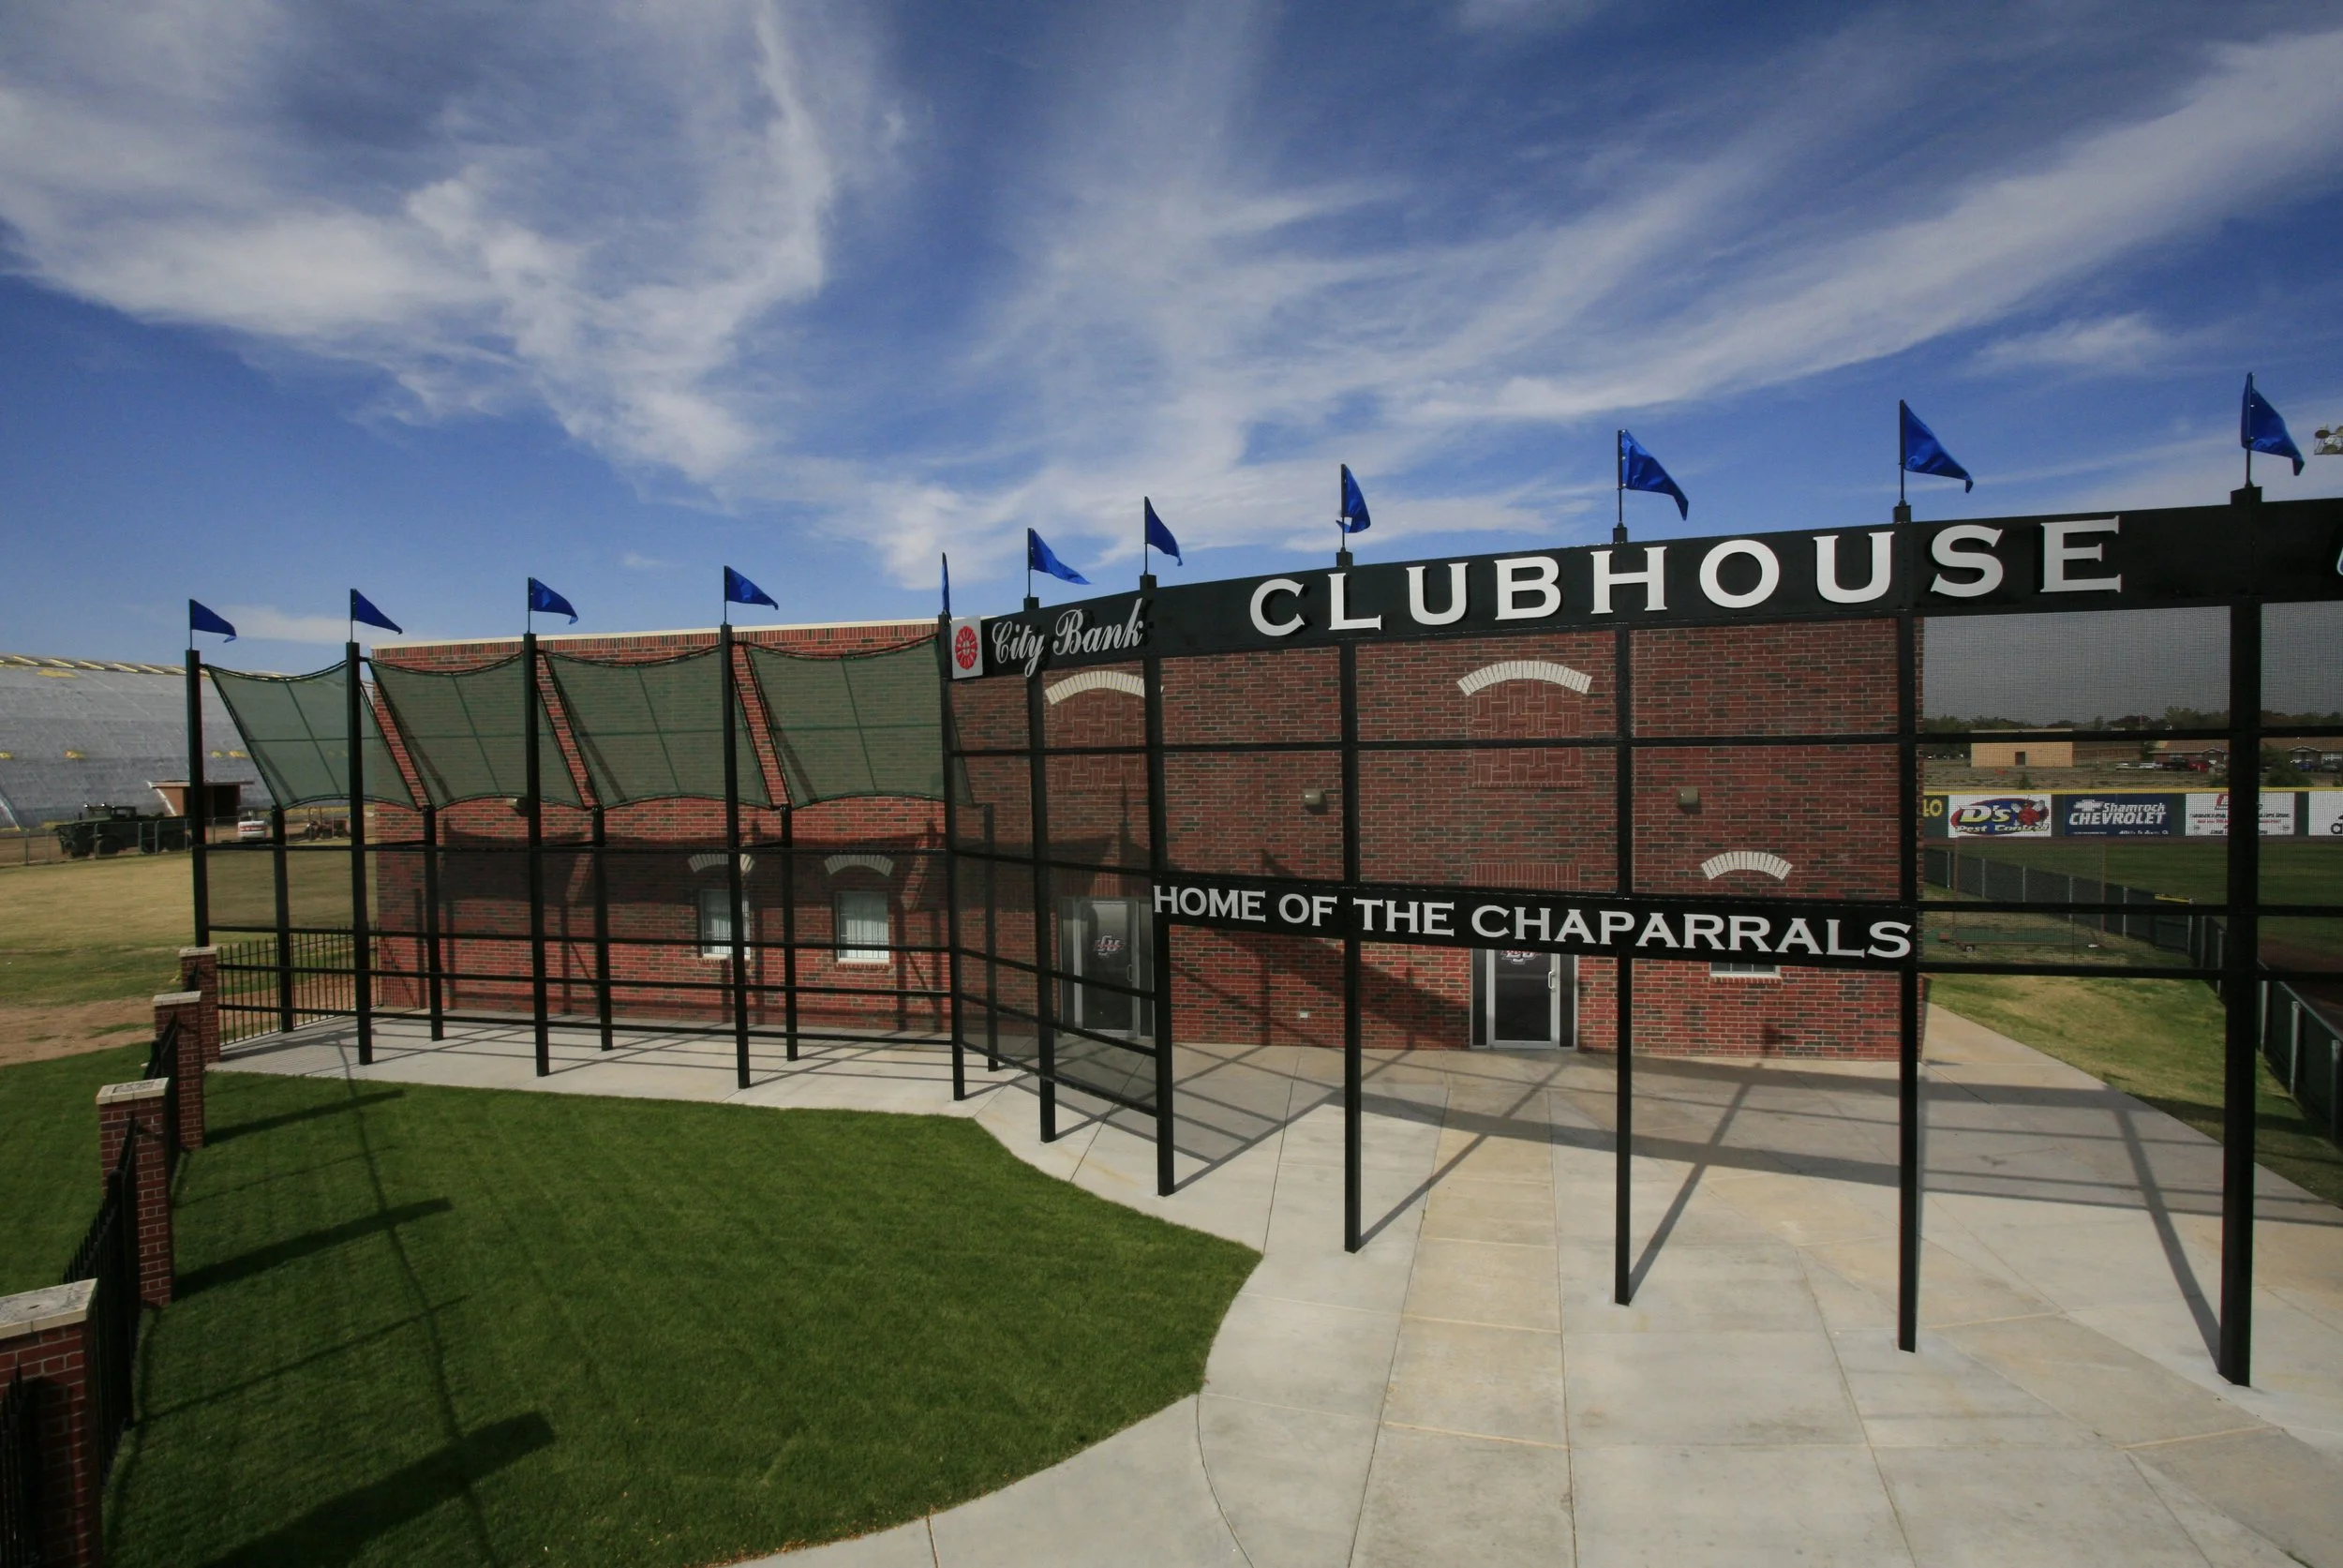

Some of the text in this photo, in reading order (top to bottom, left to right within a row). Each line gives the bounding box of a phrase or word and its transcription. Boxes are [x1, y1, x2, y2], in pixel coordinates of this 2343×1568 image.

[1249, 515, 2122, 637] CLUBHOUSE
[992, 598, 1146, 678] City Bank
[1960, 805, 2012, 823] D's
[2102, 802, 2166, 813] Shamrock
[2068, 812, 2167, 826] CHEVROLET
[1955, 825, 1988, 833] Pest
[1153, 885, 1266, 922] HOME
[1278, 893, 1337, 927] OF
[1352, 897, 1455, 936] THE
[1470, 904, 1913, 959] CHAPARRALS
